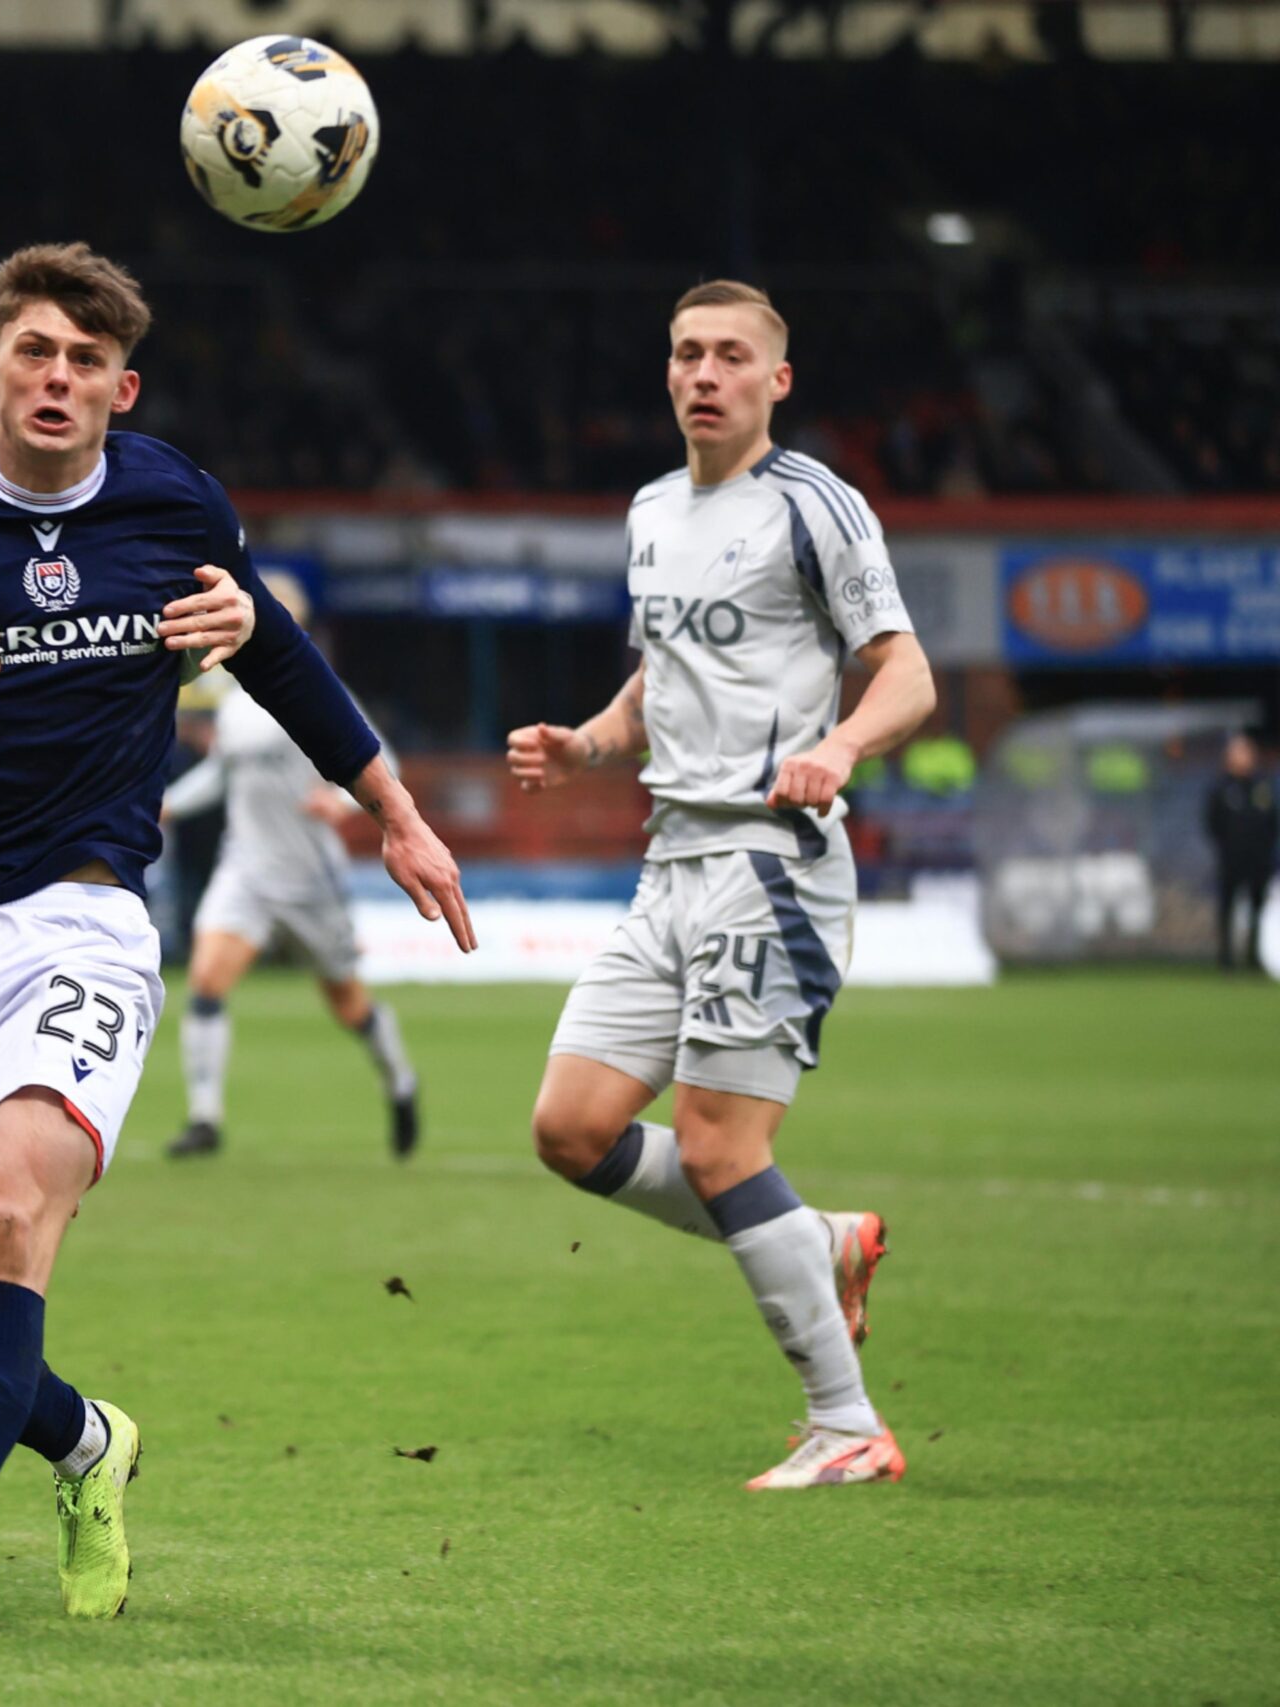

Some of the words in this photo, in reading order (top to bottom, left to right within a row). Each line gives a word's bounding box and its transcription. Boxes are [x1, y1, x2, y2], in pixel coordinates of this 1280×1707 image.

[61, 644, 118, 661] services
[699, 933, 768, 1001] 24
[36, 974, 125, 1062] 23
